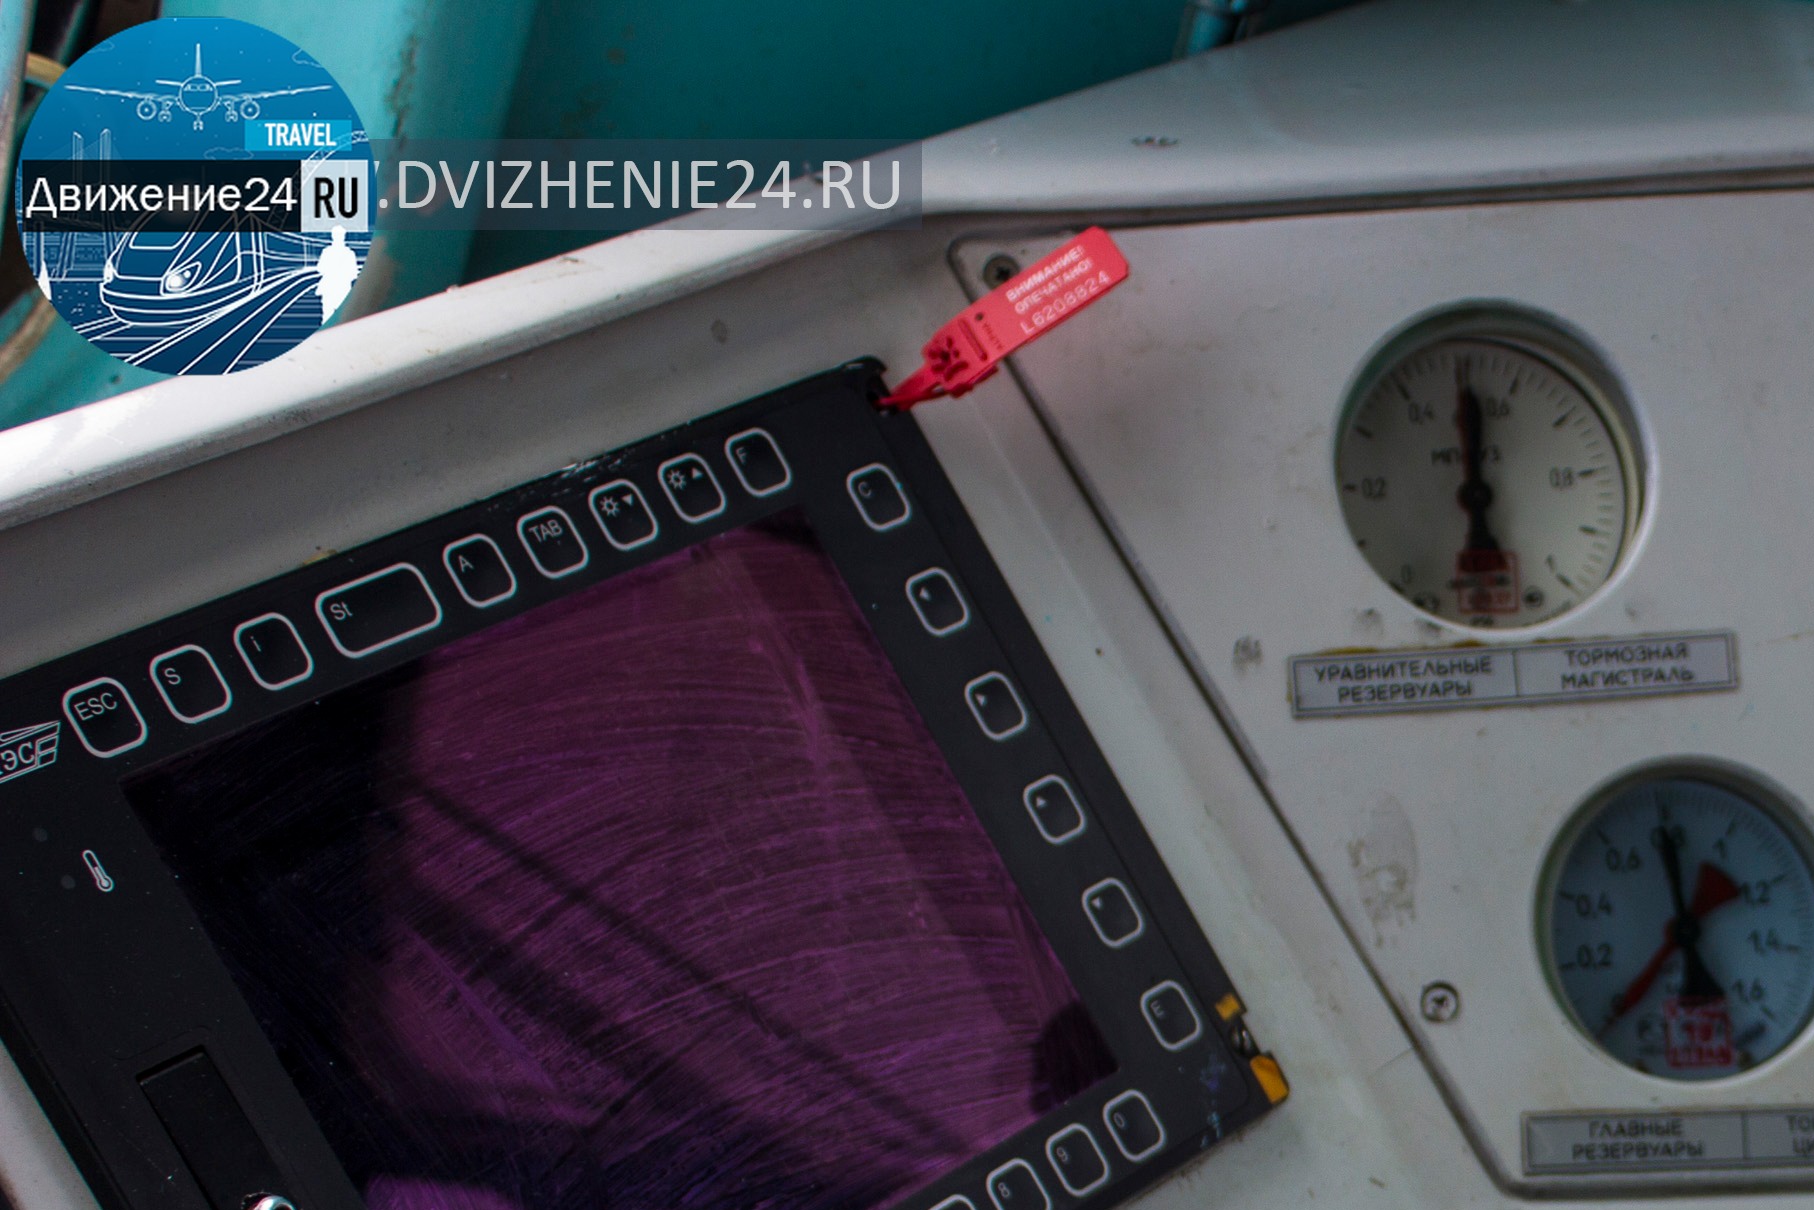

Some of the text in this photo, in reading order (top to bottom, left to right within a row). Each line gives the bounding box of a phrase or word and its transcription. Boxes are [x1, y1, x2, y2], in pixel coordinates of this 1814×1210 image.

[735, 447, 749, 466] F
[858, 480, 872, 498] C
[529, 519, 563, 543] TAB
[458, 555, 474, 572] A
[329, 601, 353, 621] St
[250, 636, 261, 652] i
[1565, 642, 1688, 664] ТОРМОЗНАЯ
[164, 667, 182, 685] S
[1313, 655, 1493, 683] УРАВНИТЕЛЬНЫЕ
[1561, 666, 1695, 690] МАГИСТРАЛЬ
[1336, 680, 1473, 703] РЕЗЕРВУАРЫ
[74, 692, 118, 721] ESC
[1113, 1113, 1125, 1129] 0
[1589, 1117, 1684, 1139] ГЛАВНЫЕ
[1056, 1146, 1069, 1163] 9
[1572, 1139, 1703, 1161] РЕЗЕРВУАРЫ
[997, 1182, 1011, 1198] 8
